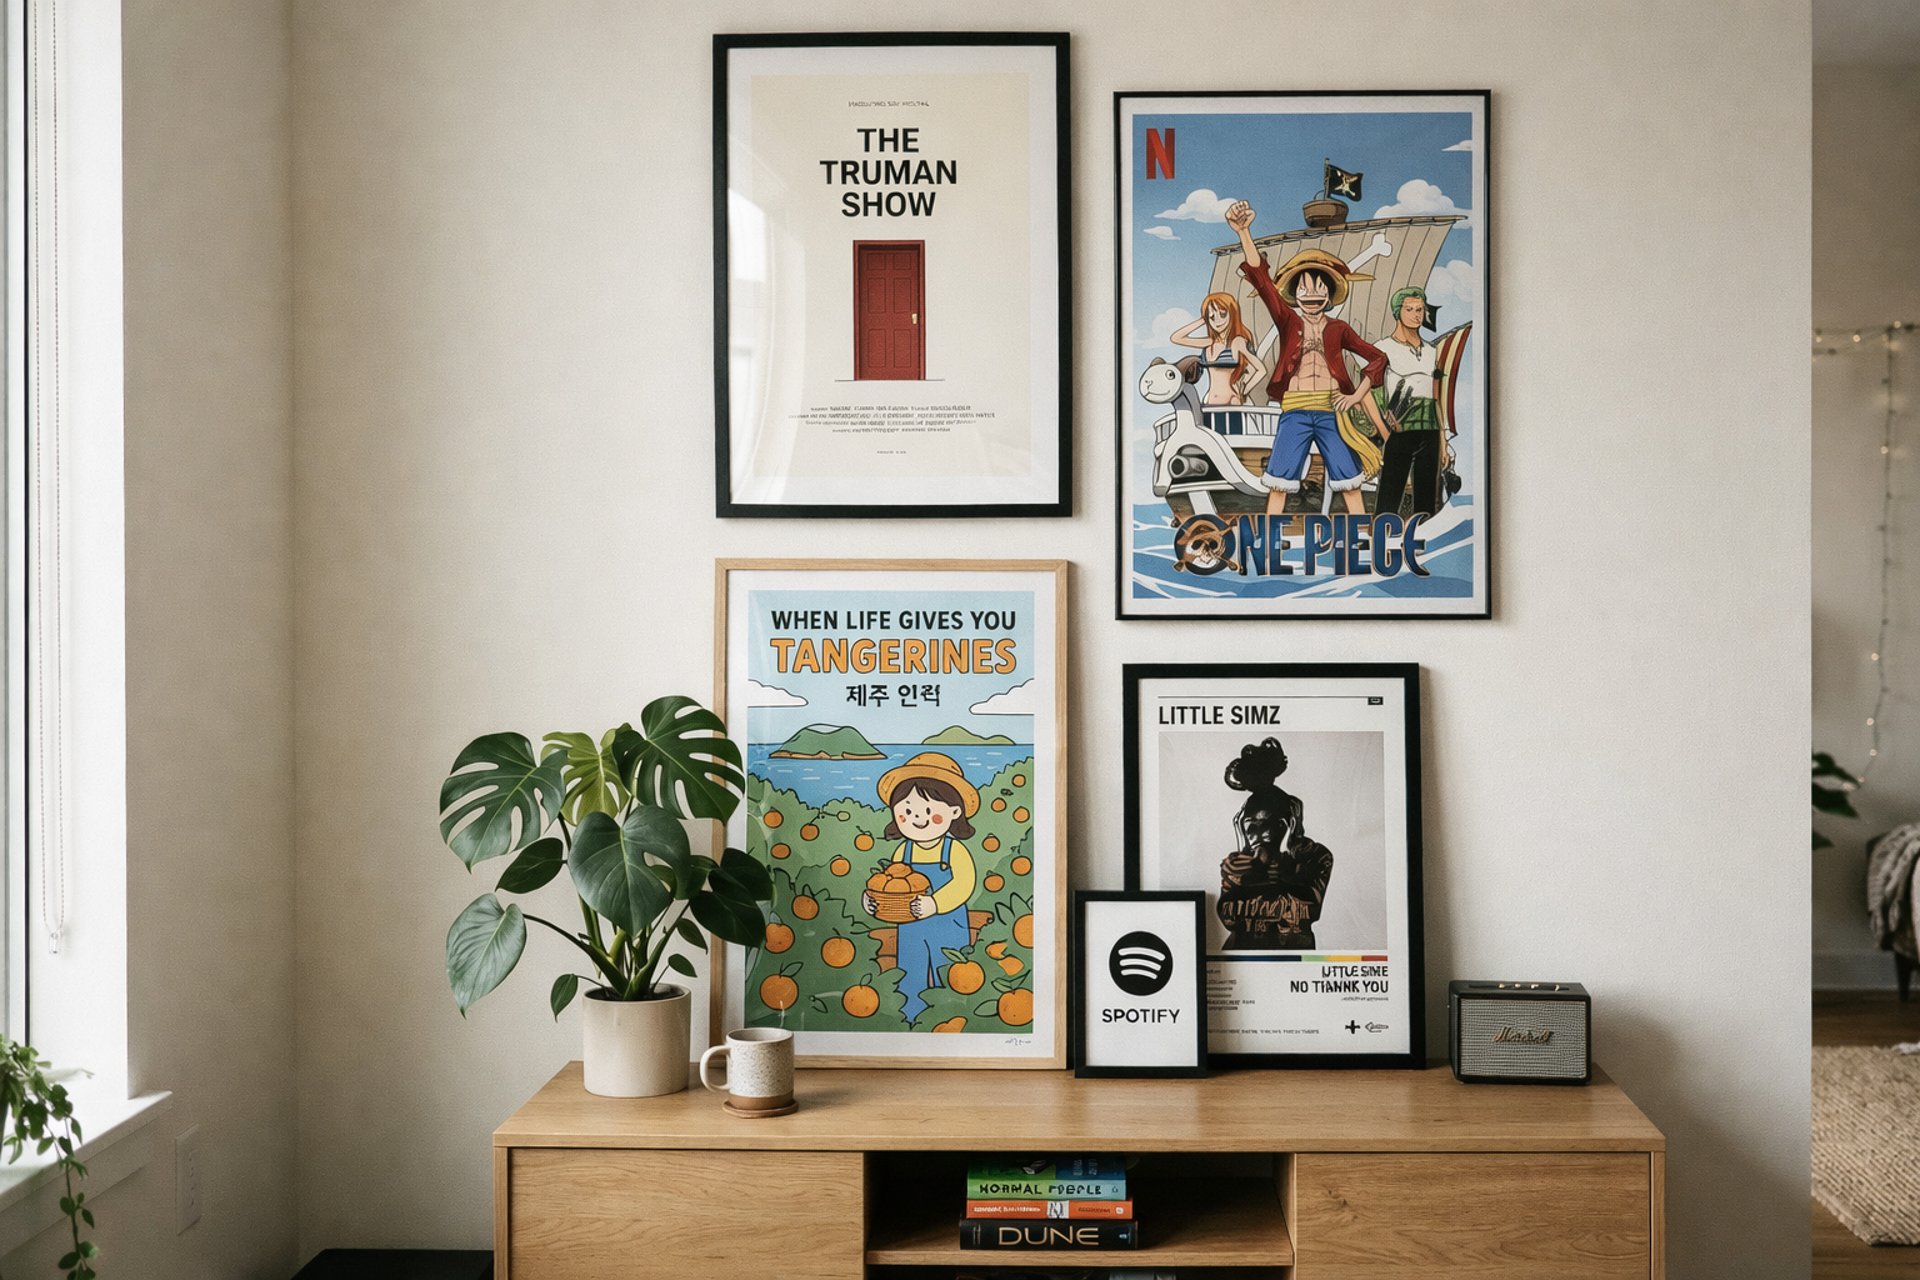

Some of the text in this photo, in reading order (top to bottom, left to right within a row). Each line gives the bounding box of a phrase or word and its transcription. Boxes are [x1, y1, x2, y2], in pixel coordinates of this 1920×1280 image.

[857, 128, 919, 153] THE
[1146, 128, 1175, 180] N
[820, 160, 957, 185] TRUMAN
[841, 192, 936, 217] SHOW
[1304, 512, 1431, 577] PIECE
[771, 611, 1016, 631] WHEN LIFE GIVES YOU
[770, 638, 1017, 674] TANGERINES
[846, 684, 889, 707] 제주
[1158, 705, 1281, 725] LITTLE SIMZ
[1290, 981, 1308, 993] NO
[1362, 981, 1389, 993] YOU
[1102, 1009, 1180, 1024] SPOTIFY
[998, 1226, 1099, 1245] DUNE
